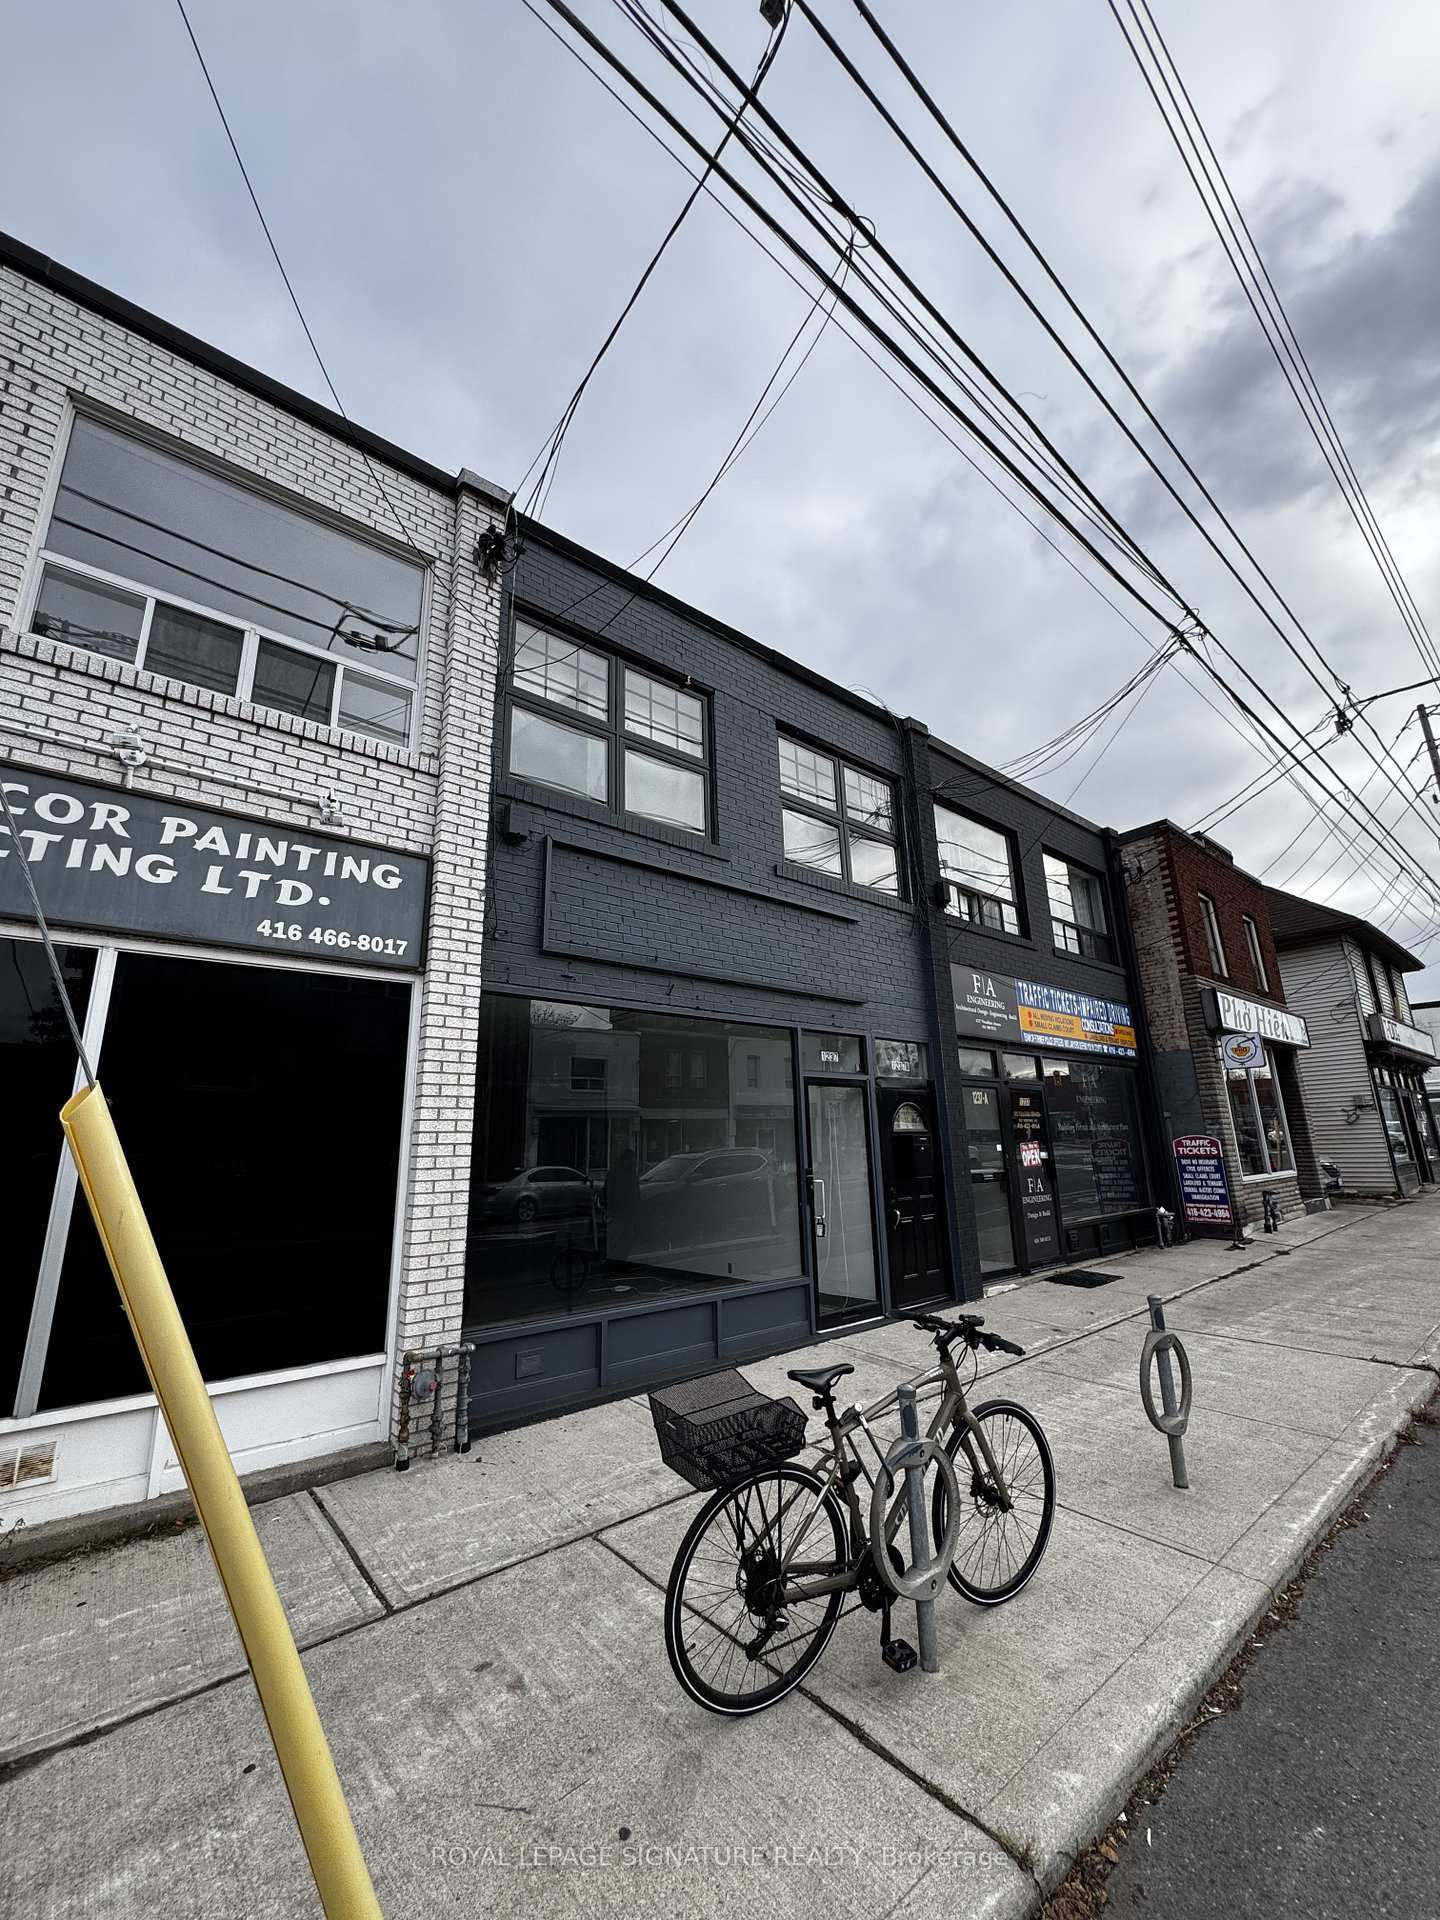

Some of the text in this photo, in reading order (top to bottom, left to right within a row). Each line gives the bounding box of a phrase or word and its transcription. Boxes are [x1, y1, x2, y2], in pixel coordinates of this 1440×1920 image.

[159, 816, 403, 889] PAINTING
[0, 825, 331, 906] TING LTD.
[256, 919, 408, 956] 416 466-8017
[966, 994, 1005, 1010] ENGINEERING
[1018, 982, 1049, 1009] TRAFFIC
[1177, 1147, 1218, 1155] TICKETS
[1181, 1139, 1211, 1147] TRAFFIC
[1022, 1149, 1041, 1167] OPEN
[1022, 1194, 1052, 1204] ENGINEERING
